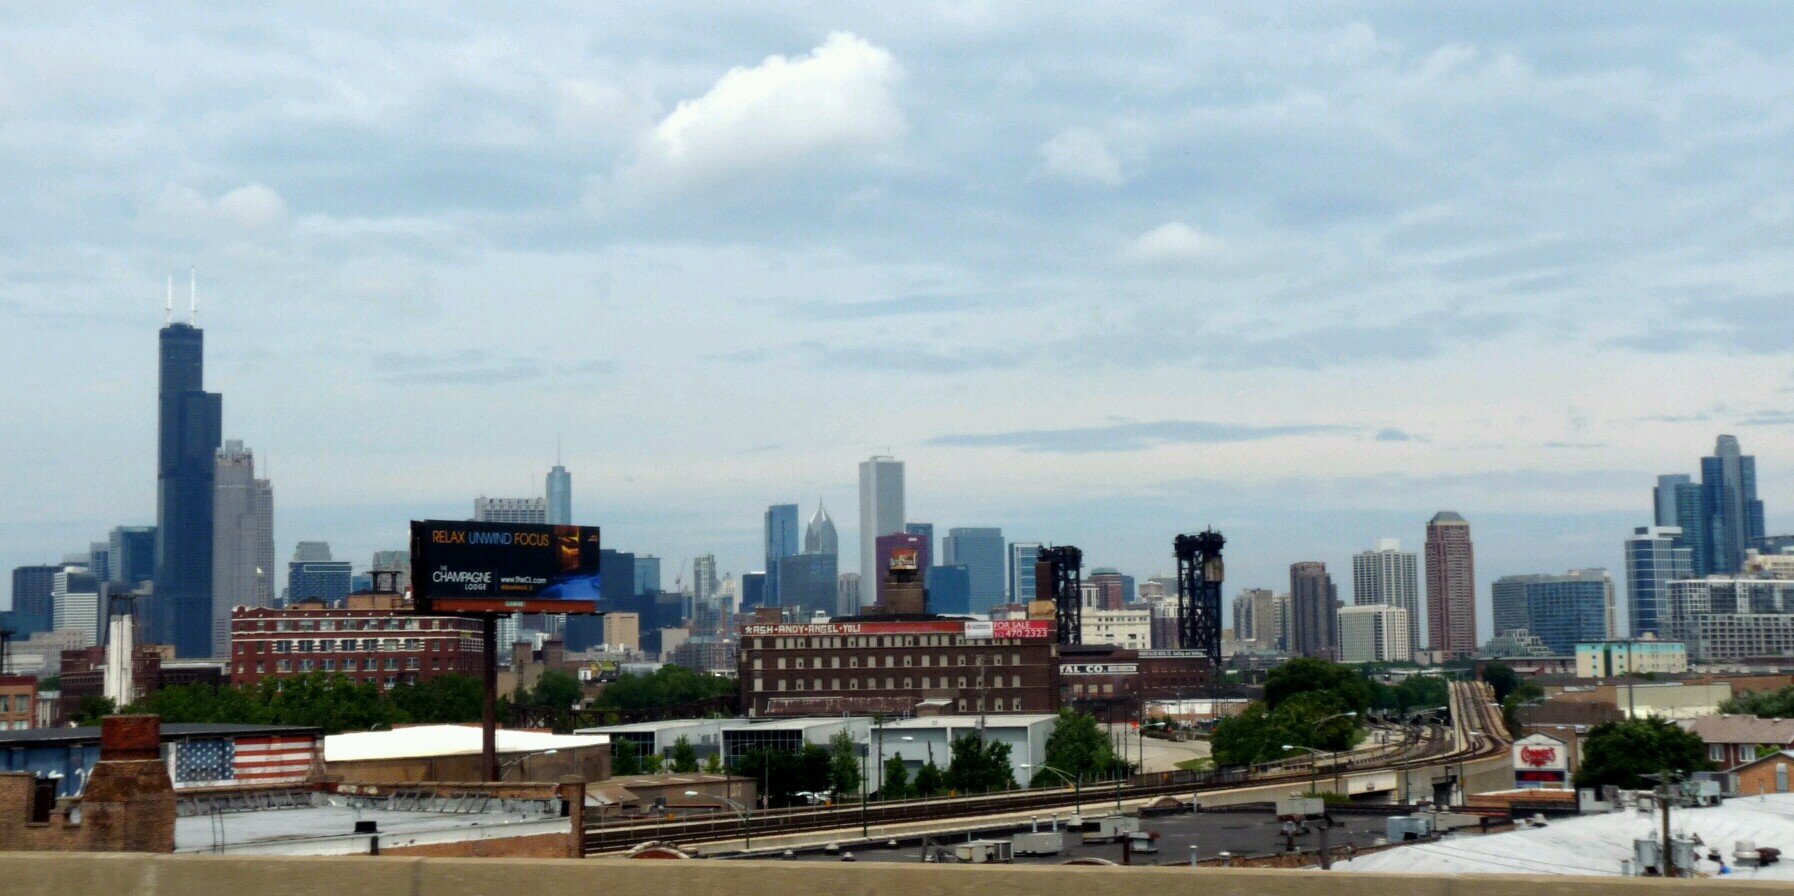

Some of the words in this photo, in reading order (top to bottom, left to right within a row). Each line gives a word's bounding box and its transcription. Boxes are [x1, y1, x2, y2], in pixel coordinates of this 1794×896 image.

[432, 530, 465, 544] RELAX
[468, 531, 512, 545] UNWIND
[514, 532, 550, 547] FOCUS
[432, 571, 492, 583] CHAMPAGNE
[465, 583, 487, 591] LODGE
[778, 624, 805, 634] ANDY
[808, 624, 839, 634] ANGEL
[993, 621, 1010, 629] FOR
[1012, 621, 1030, 629] SALE
[1005, 629, 1048, 638] 470.2323
[1085, 665, 1107, 673] CO.
